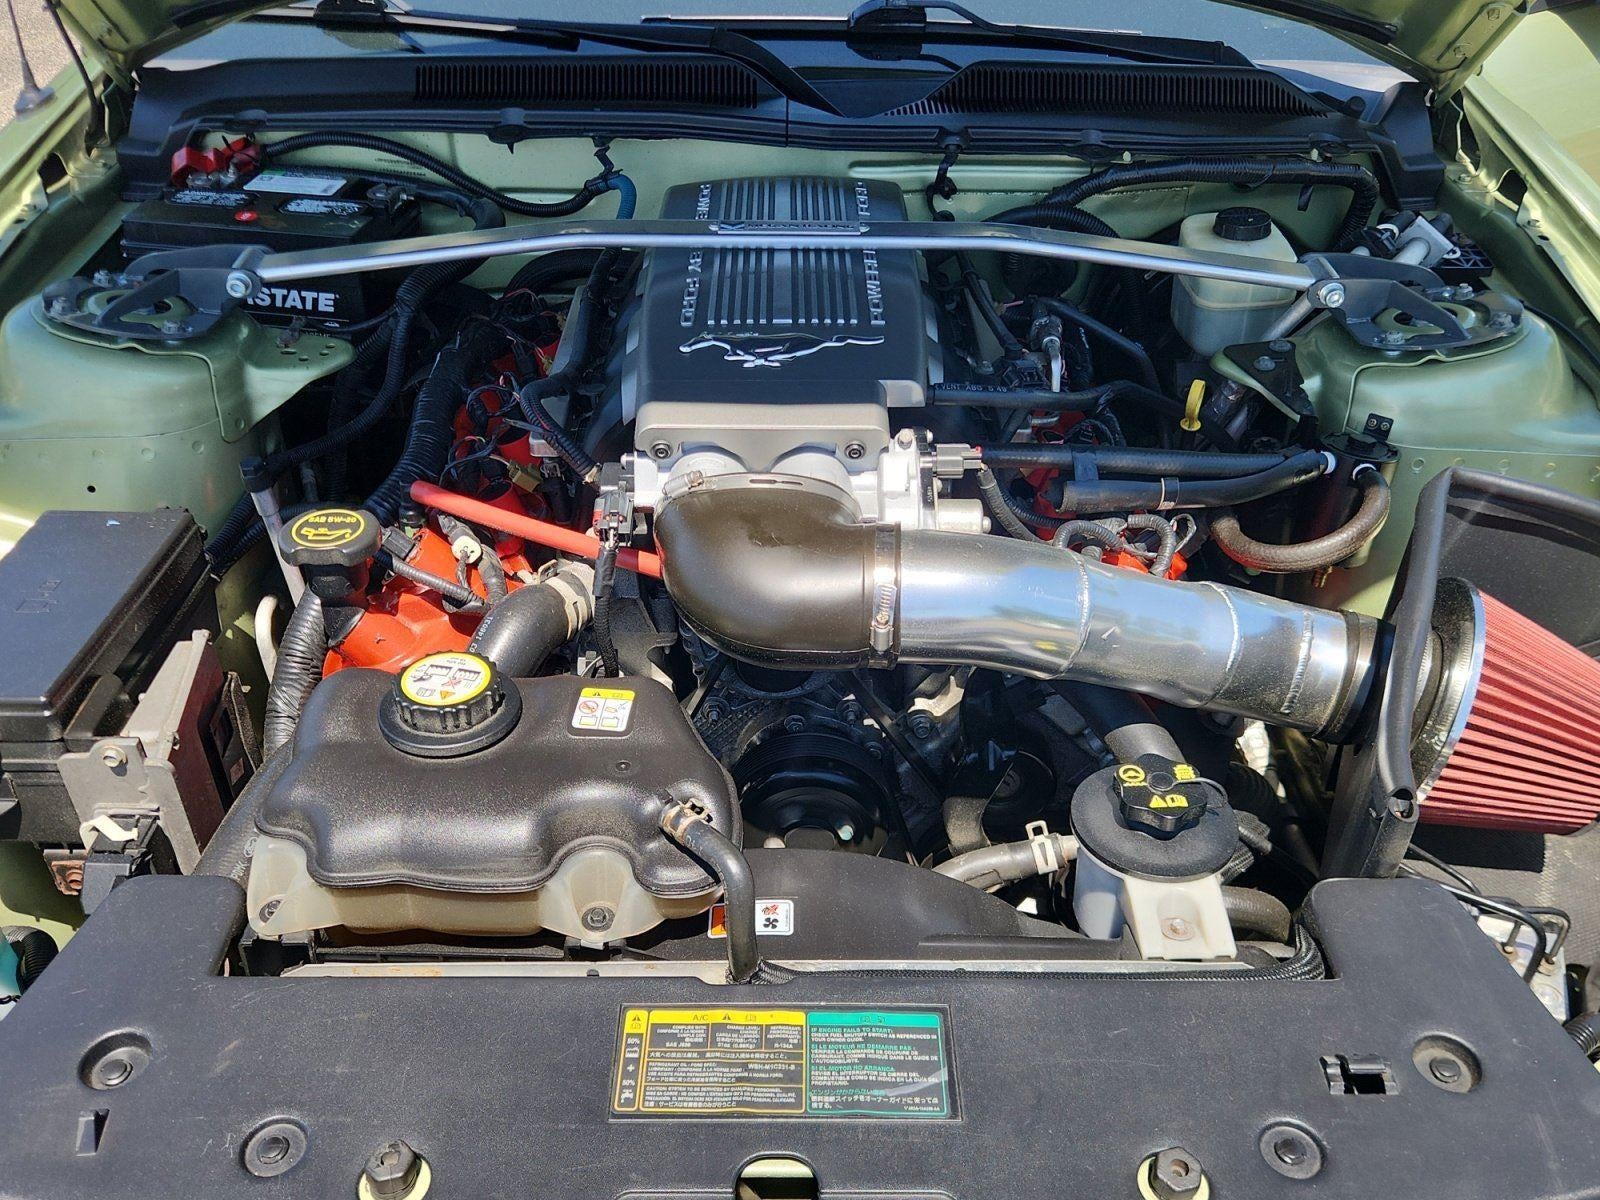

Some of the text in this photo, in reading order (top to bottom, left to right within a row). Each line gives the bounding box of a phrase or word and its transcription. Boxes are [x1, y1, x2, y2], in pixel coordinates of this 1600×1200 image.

[695, 183, 712, 220] POWE
[247, 286, 335, 313] STATE
[679, 276, 700, 328] FORD
[862, 248, 886, 327] POWERE
